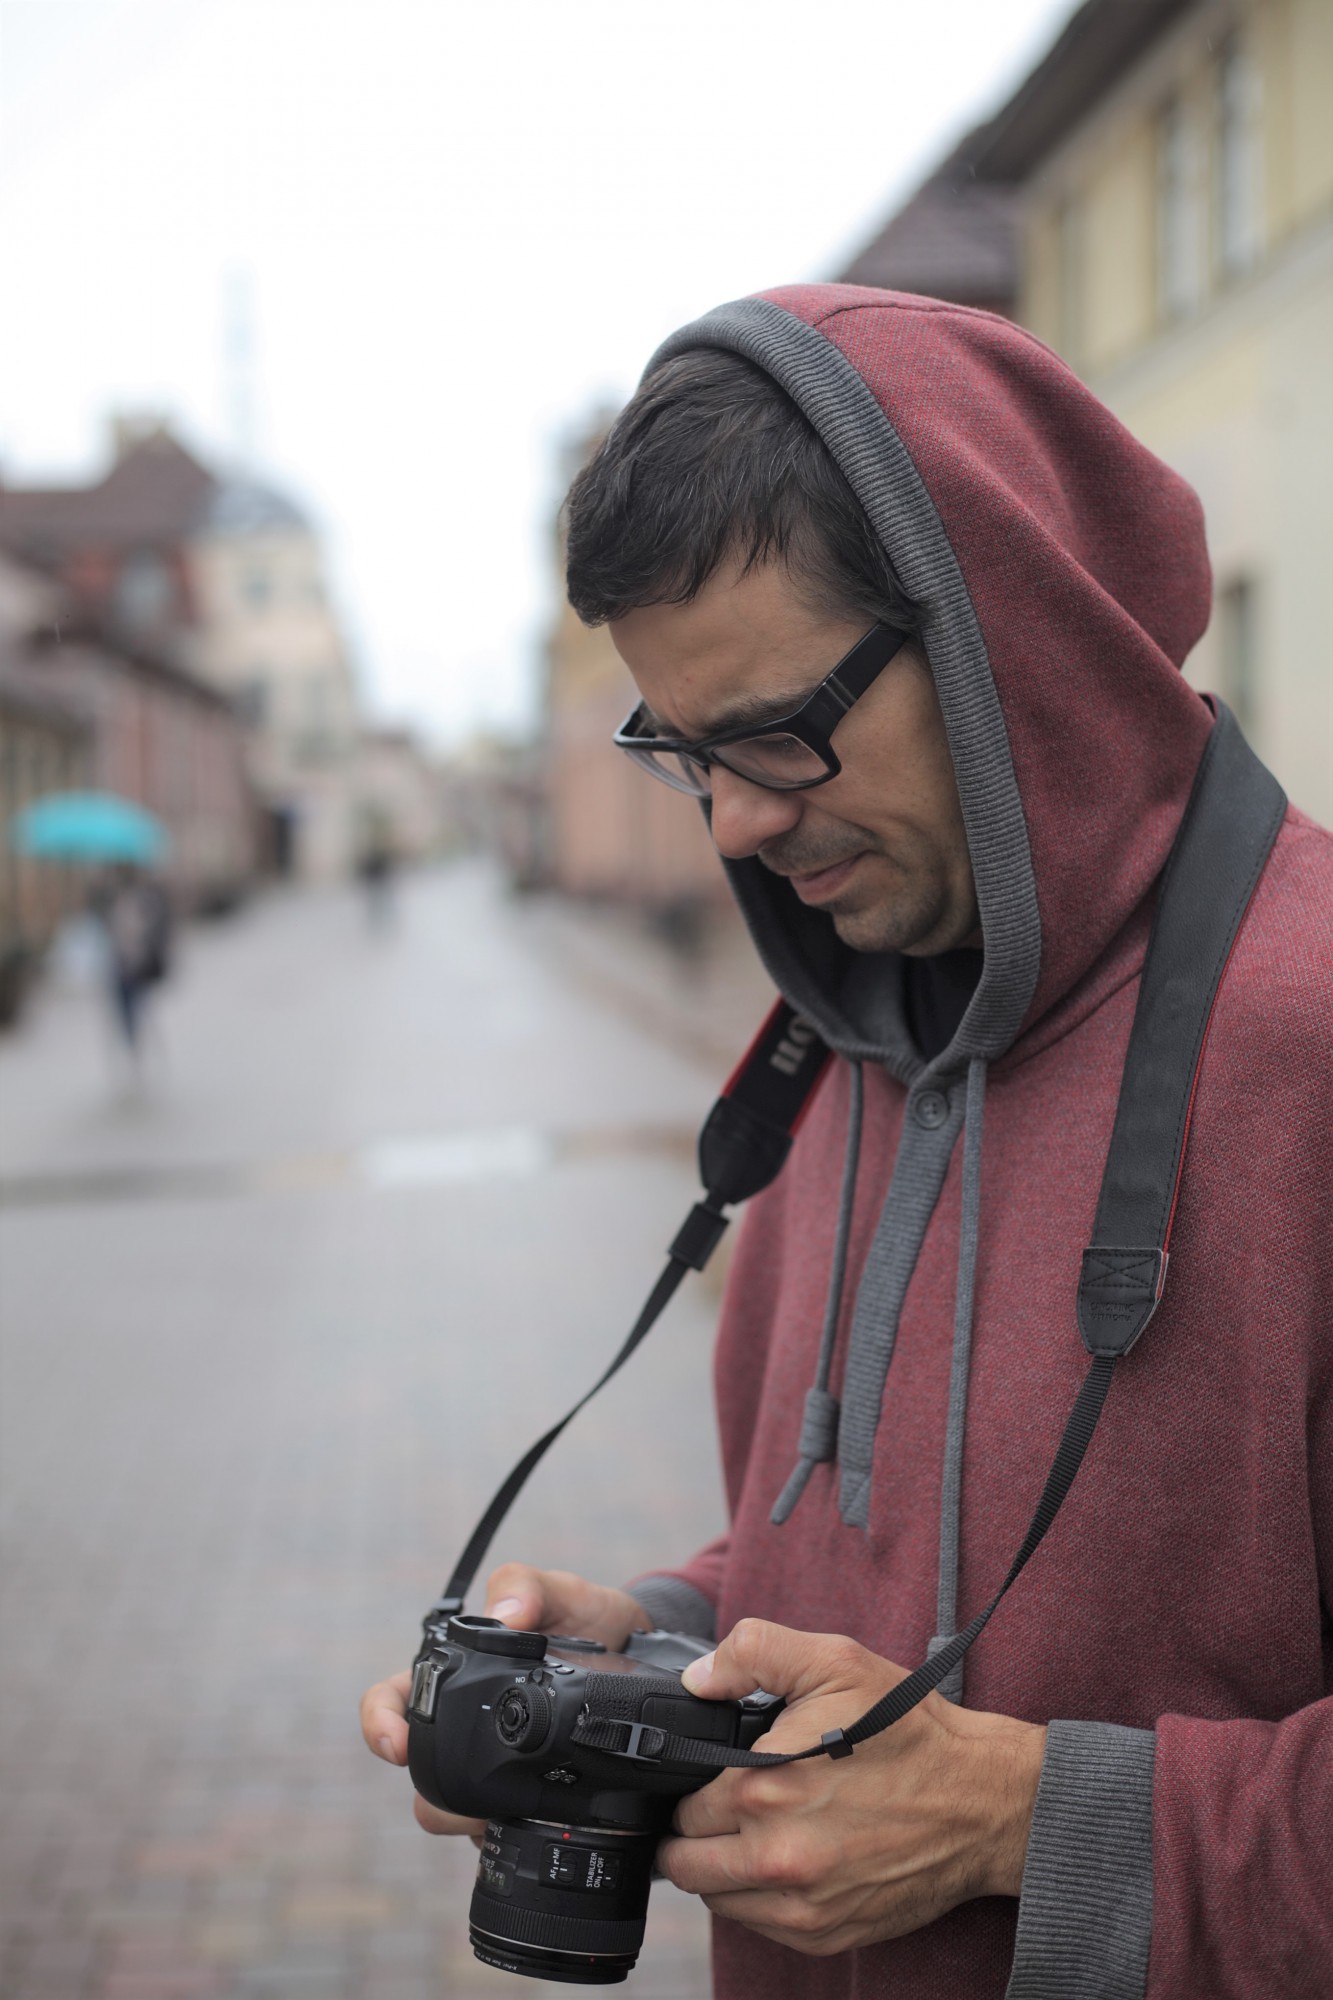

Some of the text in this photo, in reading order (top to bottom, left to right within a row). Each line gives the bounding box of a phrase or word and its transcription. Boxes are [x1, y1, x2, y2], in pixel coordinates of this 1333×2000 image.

[549, 1847, 560, 1880] AF MF
[585, 1852, 598, 1888] STABILIZER
[593, 1857, 604, 1888] ON OFF
